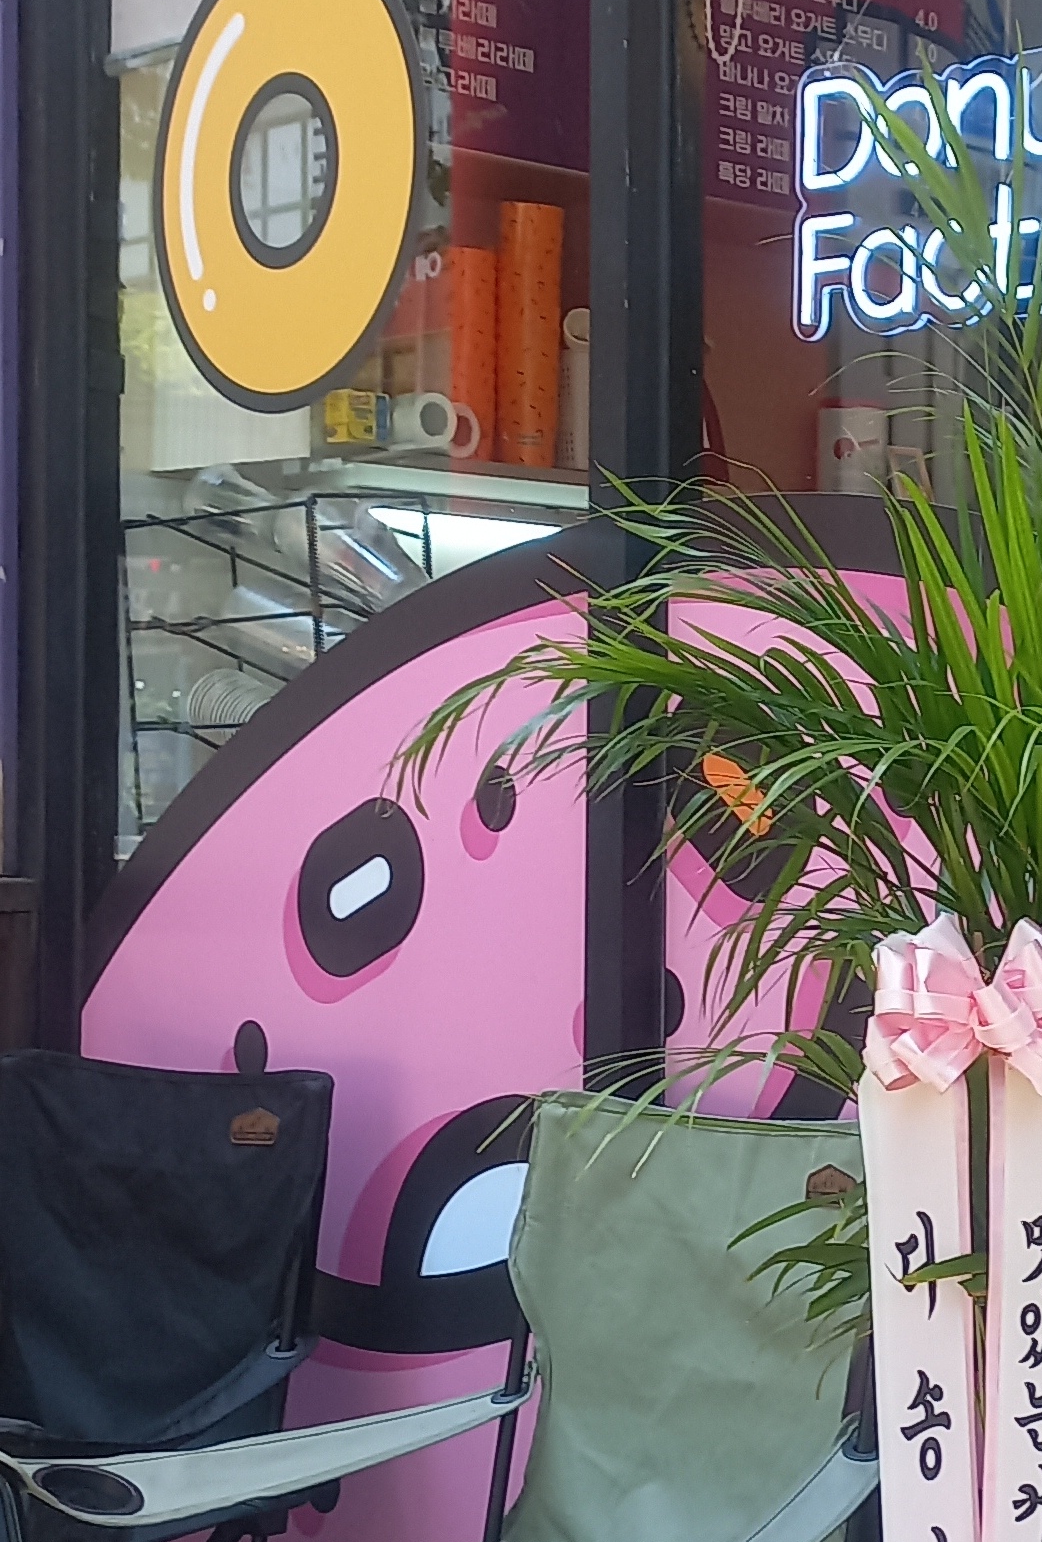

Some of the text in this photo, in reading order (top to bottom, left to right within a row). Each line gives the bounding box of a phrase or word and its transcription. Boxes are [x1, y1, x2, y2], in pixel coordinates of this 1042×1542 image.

[719, 24, 753, 53] 망고
[757, 38, 805, 67] 요거트
[790, 12, 837, 41] 요거트
[842, 23, 888, 51] 스무디
[718, 60, 770, 91] 바나나
[718, 92, 752, 120] 크림
[718, 127, 790, 162] 크림 라떼
[755, 168, 790, 196] 라떼
